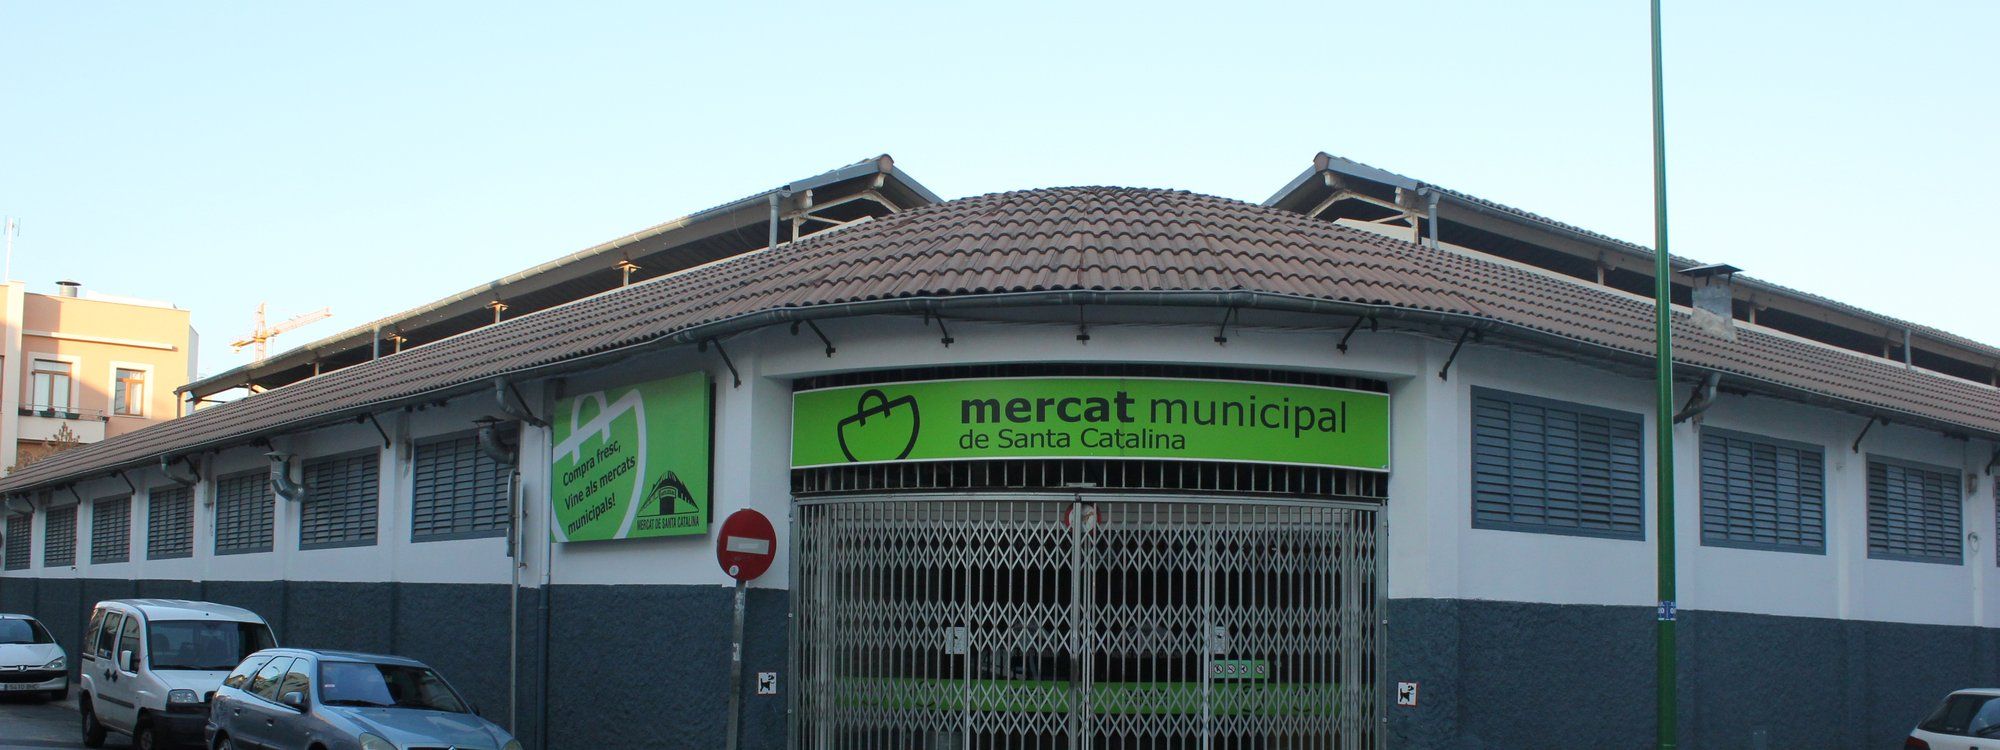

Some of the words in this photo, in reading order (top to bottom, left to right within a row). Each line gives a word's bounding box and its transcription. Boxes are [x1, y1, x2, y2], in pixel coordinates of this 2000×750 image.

[961, 391, 1135, 424] mercat
[1150, 395, 1346, 438] municipal
[959, 429, 989, 449] de
[998, 428, 1071, 449] Santa
[1080, 427, 1186, 450] Catalina
[562, 457, 595, 487] Compra
[596, 440, 621, 463] fresc,
[564, 490, 584, 510] Vine
[585, 480, 598, 498] als
[599, 455, 636, 488] mercats
[568, 492, 616, 536] municipals!
[637, 518, 655, 530] MERCAT
[655, 517, 662, 529] DE
[662, 517, 676, 529] SANTA
[677, 515, 700, 528] CATALINA
